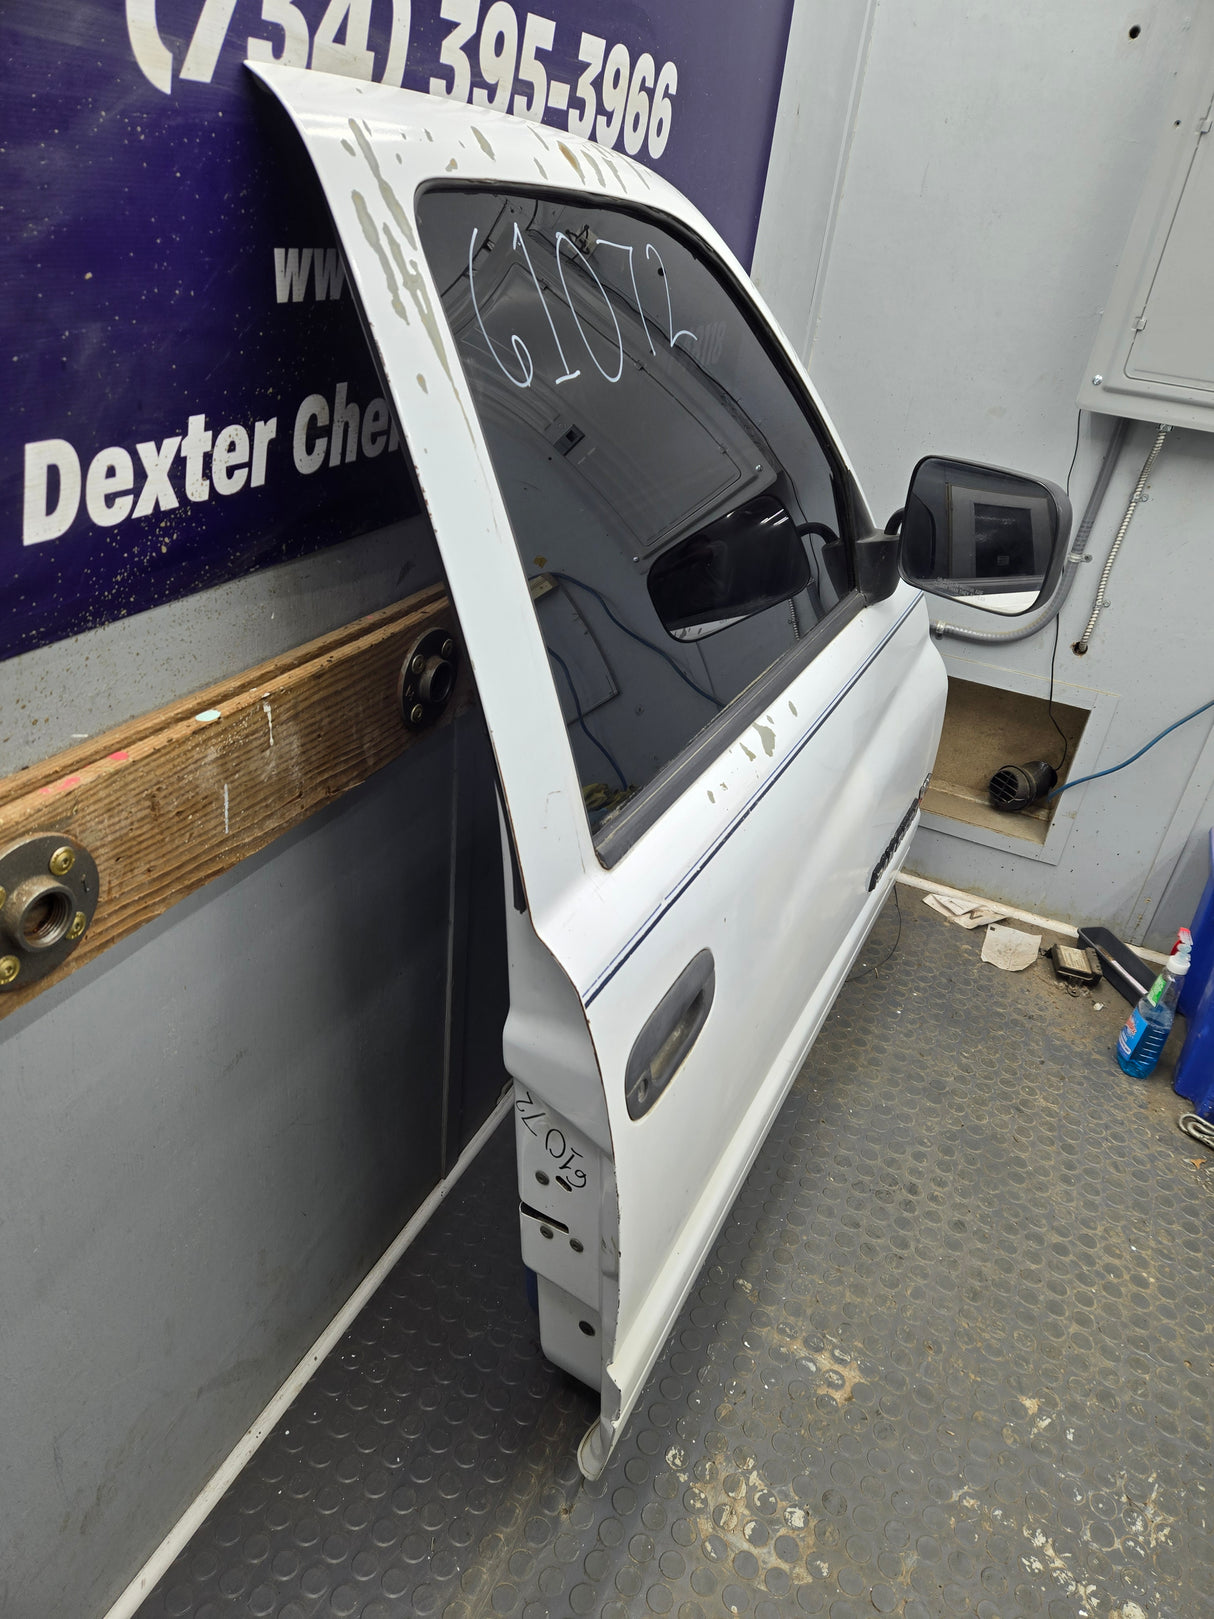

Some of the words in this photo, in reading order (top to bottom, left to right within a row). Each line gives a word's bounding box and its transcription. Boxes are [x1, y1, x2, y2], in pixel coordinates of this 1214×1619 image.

[429, 0, 679, 159] 395-3966
[469, 222, 698, 388] 61072
[23, 413, 278, 547] Dexter
[515, 1090, 587, 1189] 61072
